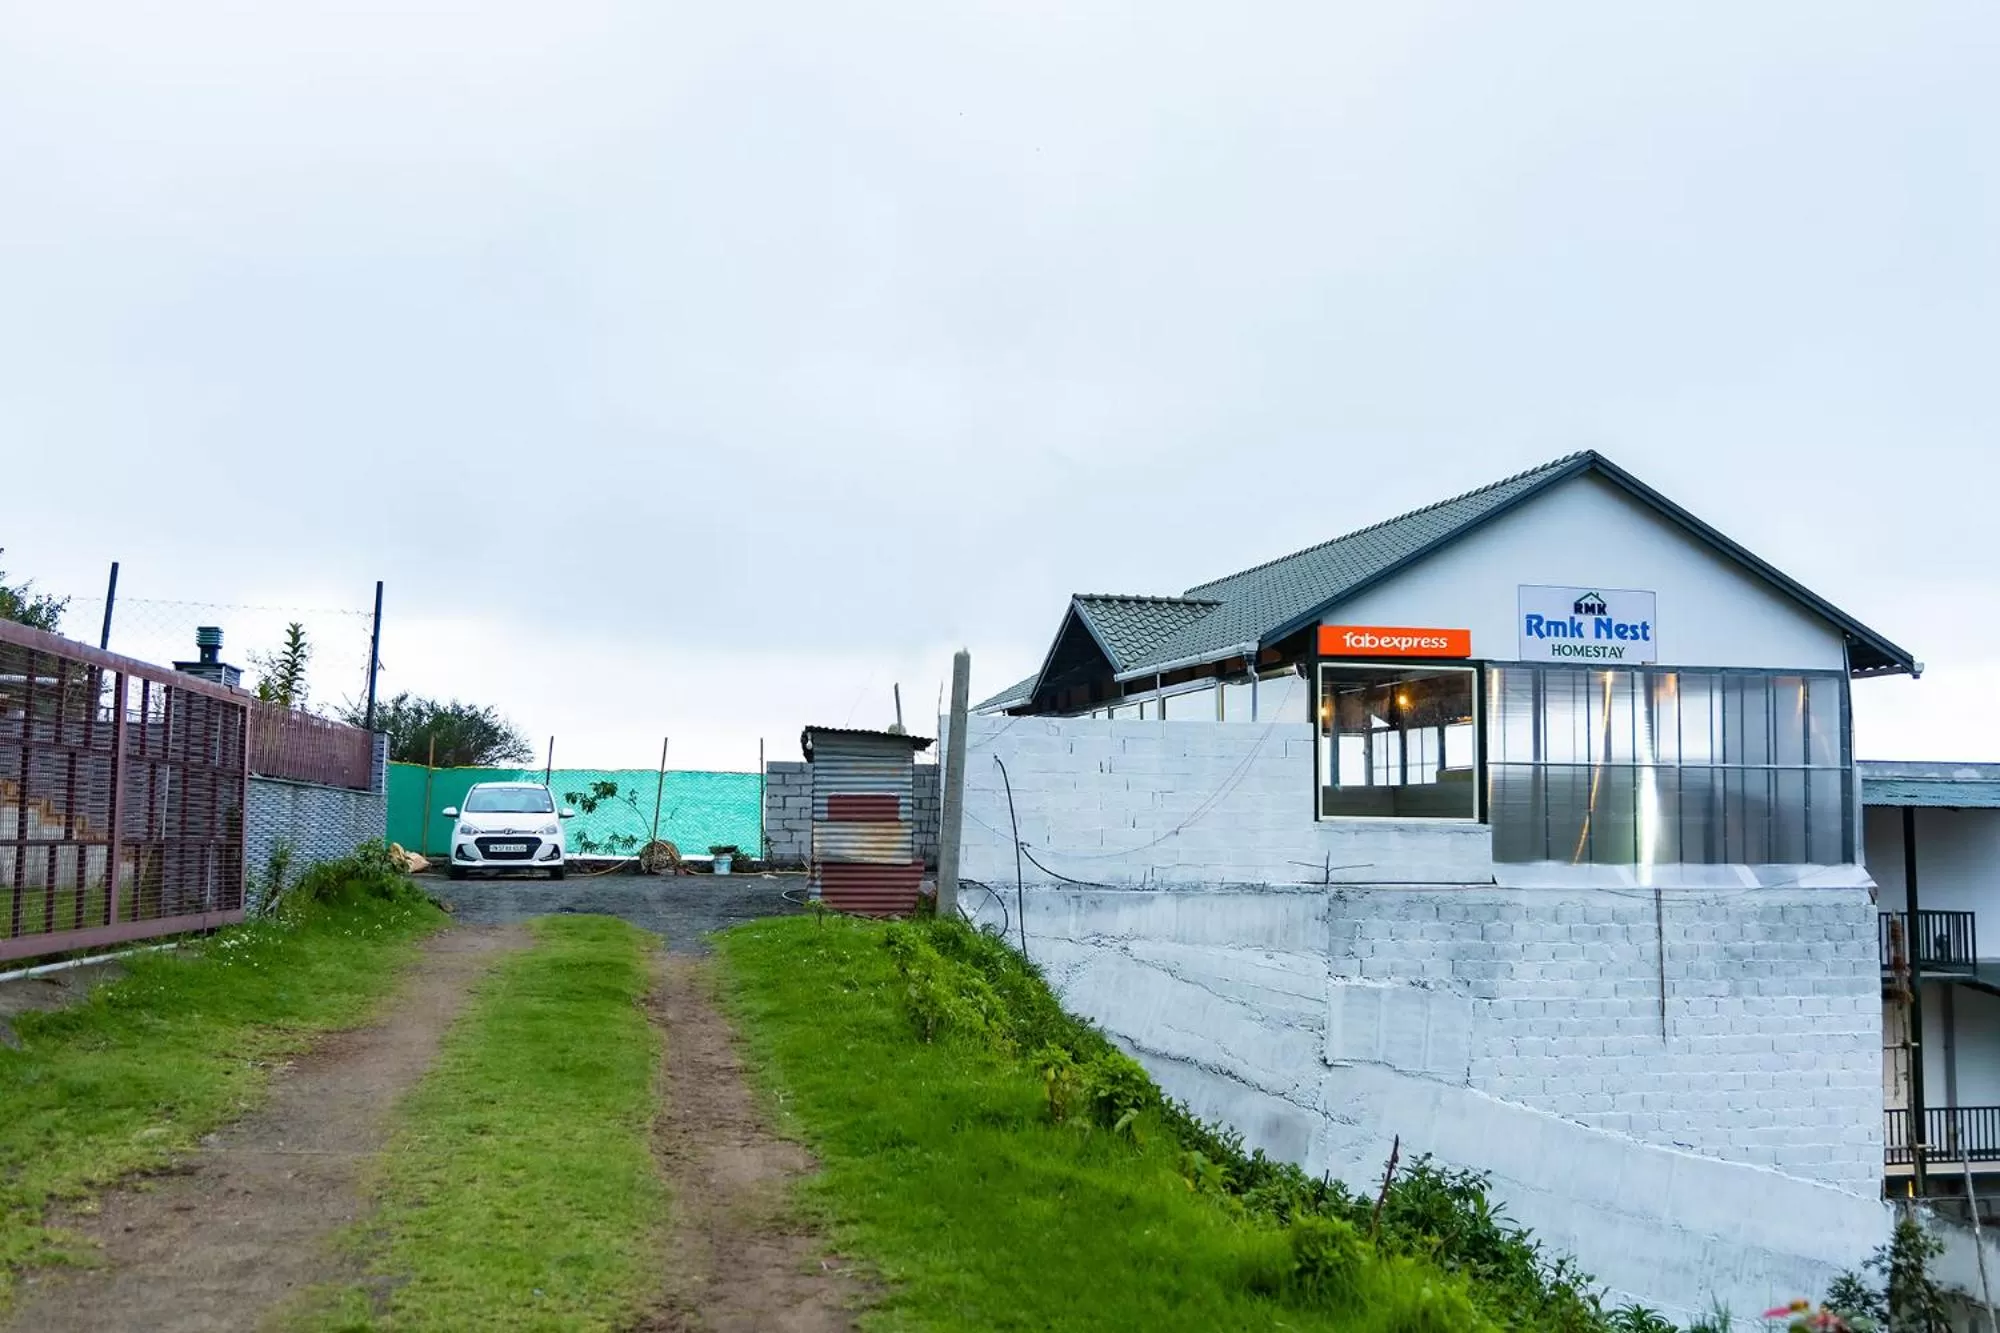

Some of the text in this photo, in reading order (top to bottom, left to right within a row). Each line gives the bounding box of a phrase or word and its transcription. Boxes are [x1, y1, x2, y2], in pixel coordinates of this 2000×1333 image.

[1574, 602, 1607, 615] RMK
[1525, 614, 1650, 641] Rmk Nest
[1551, 644, 1625, 658] HOMESTAY
